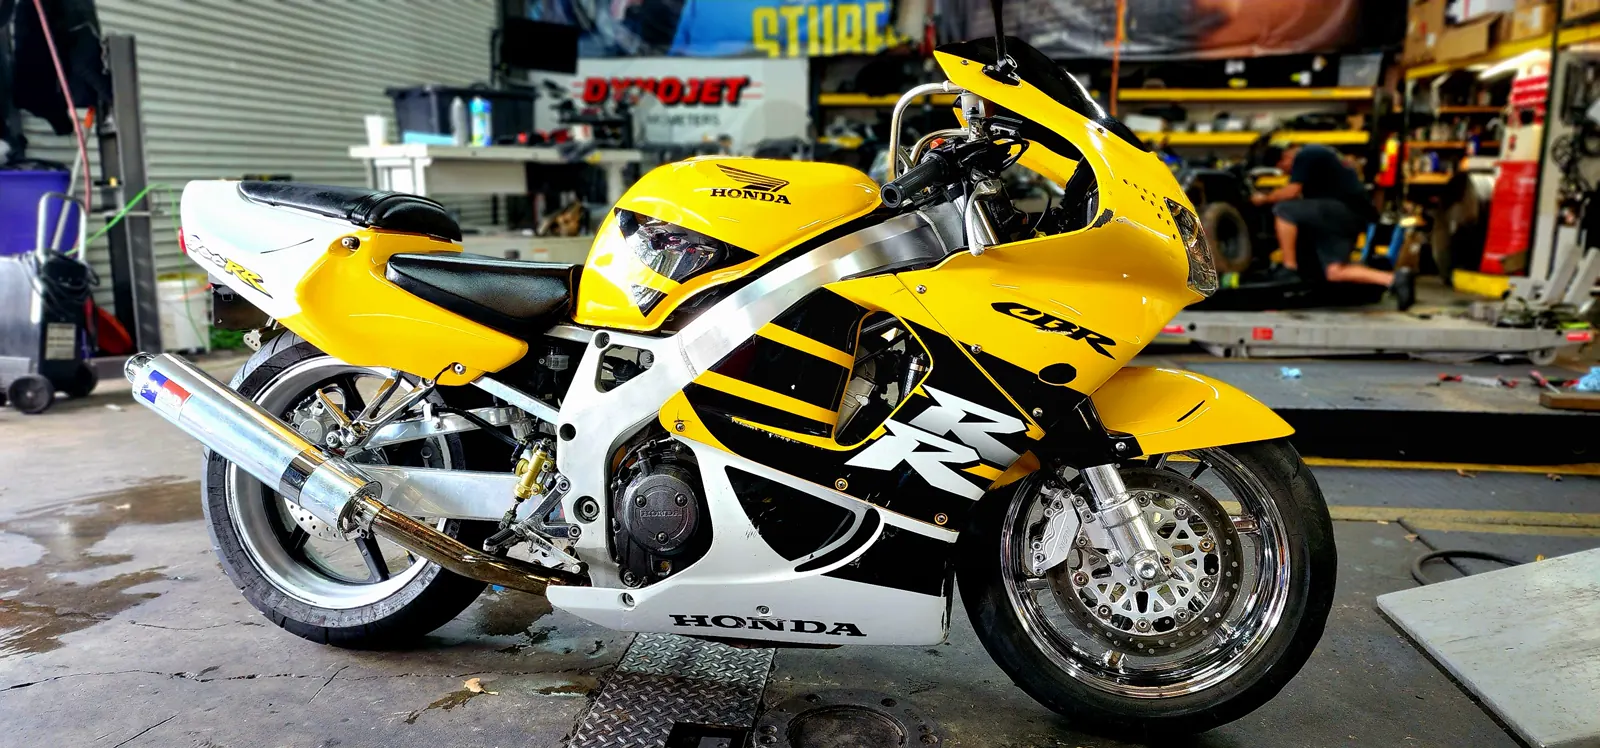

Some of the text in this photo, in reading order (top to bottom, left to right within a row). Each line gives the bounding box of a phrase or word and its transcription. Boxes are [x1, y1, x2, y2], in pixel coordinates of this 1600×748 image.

[710, 188, 791, 205] HONDA
[990, 302, 1117, 361] CBR
[640, 510, 683, 518] HONDA
[669, 614, 867, 637] HONDA
